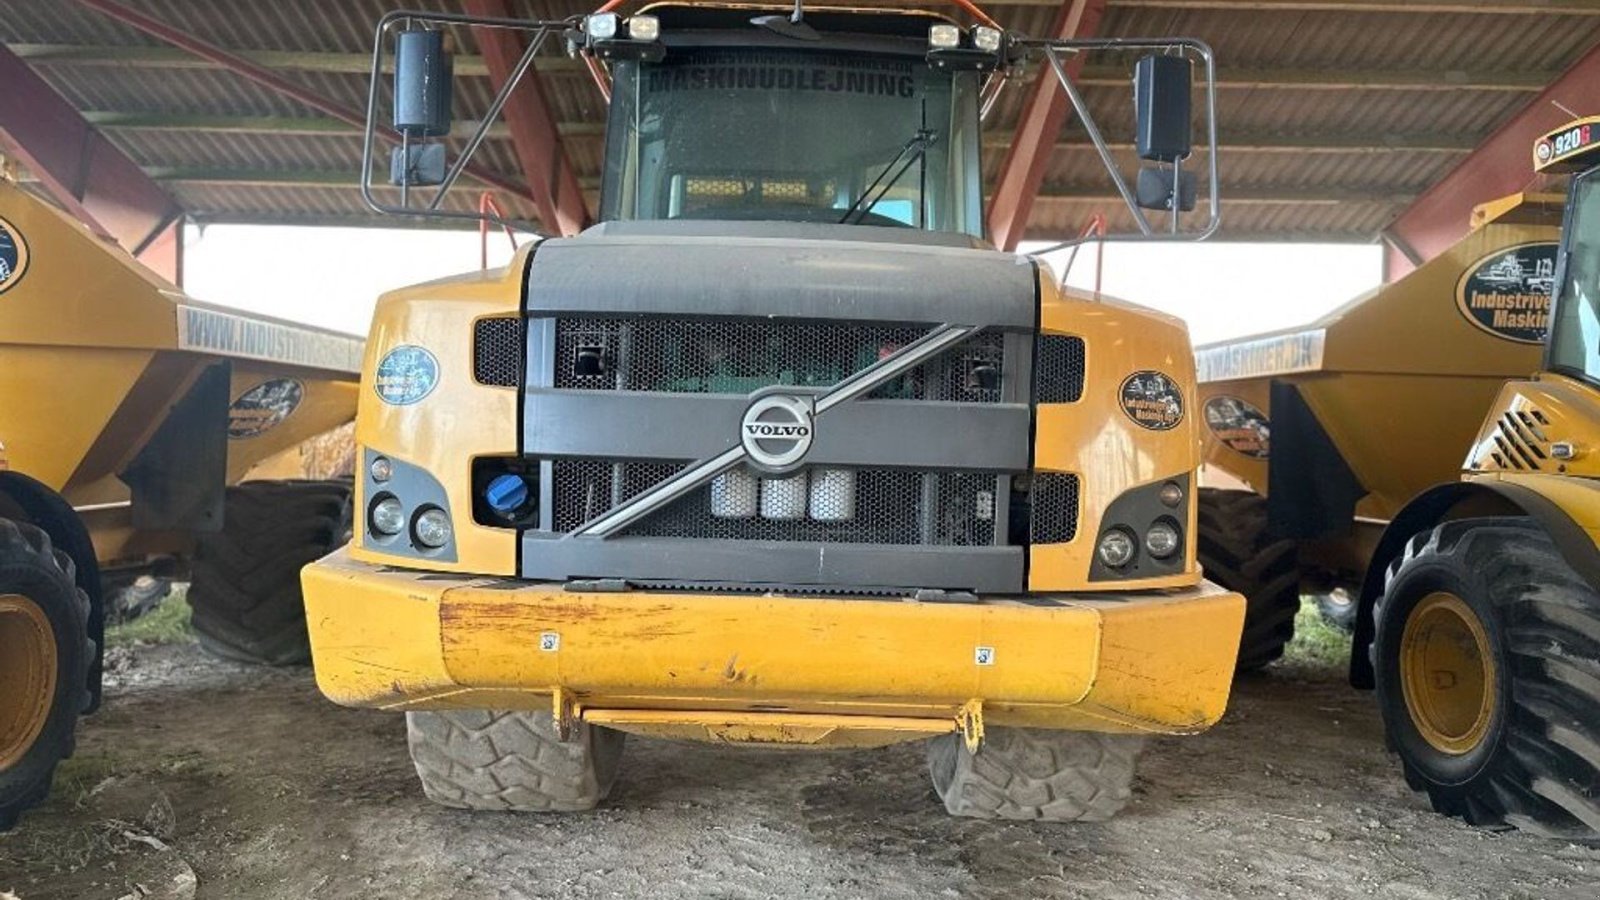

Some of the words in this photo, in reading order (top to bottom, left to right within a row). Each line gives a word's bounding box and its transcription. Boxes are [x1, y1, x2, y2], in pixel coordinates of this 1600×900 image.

[650, 66, 914, 98] MASKINUDLEJNING
[1471, 290, 1551, 309] Industrive
[745, 424, 809, 437] VOLVO
